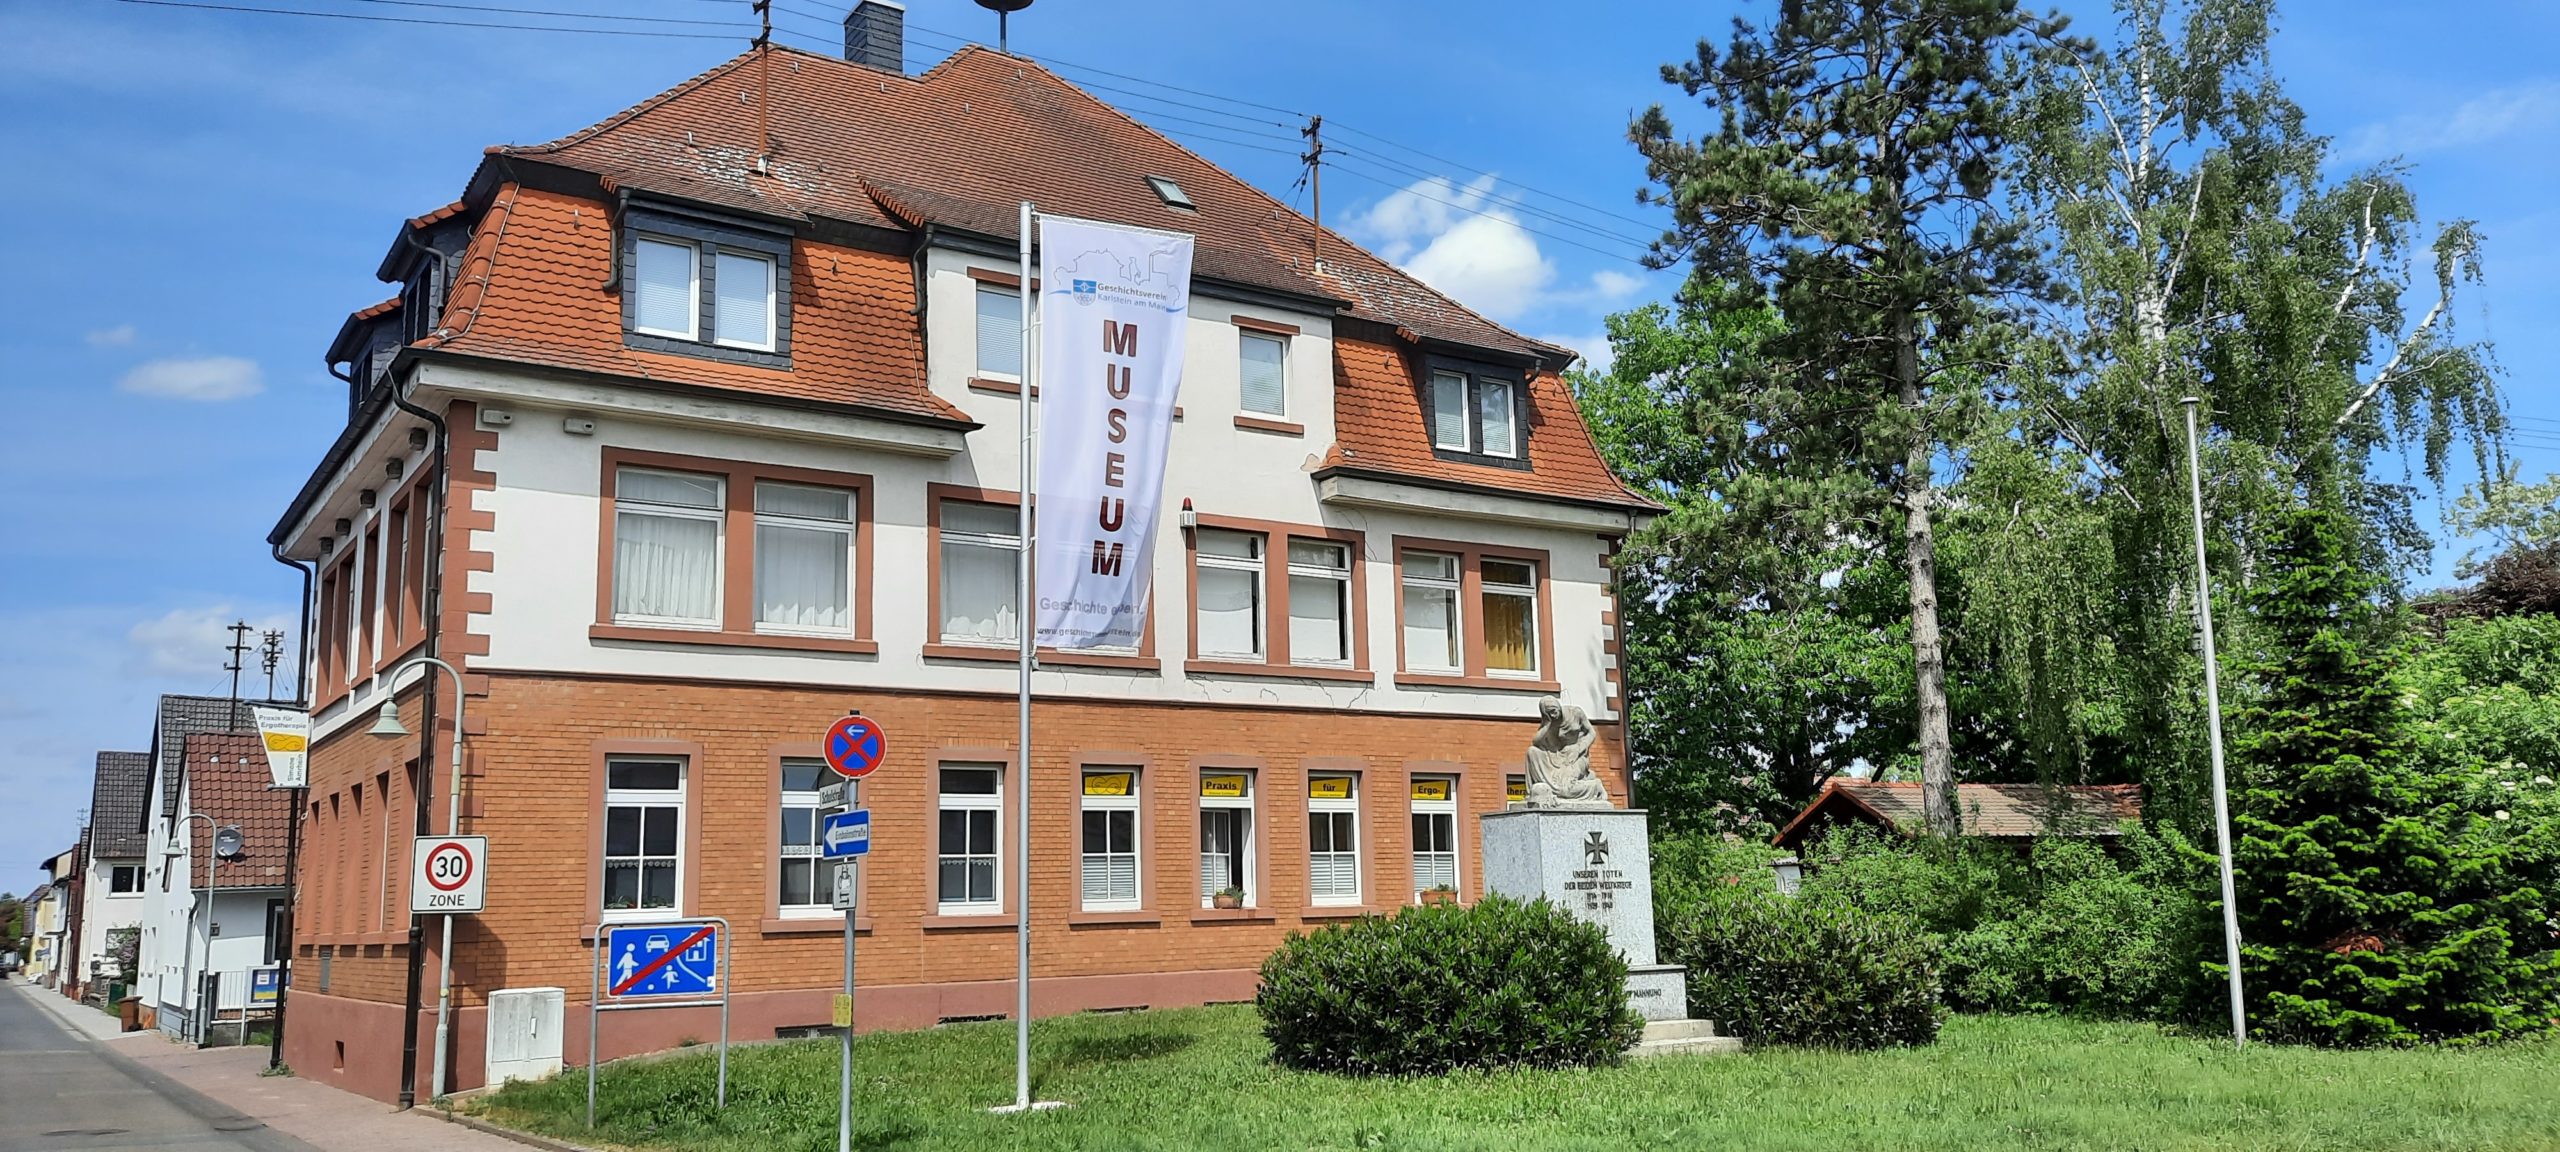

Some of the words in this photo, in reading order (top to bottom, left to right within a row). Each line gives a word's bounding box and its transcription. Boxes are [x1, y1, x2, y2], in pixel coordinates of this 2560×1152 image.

[1097, 282, 1167, 301] Geschichtsverein
[1097, 293, 1132, 305] Karlstein
[1149, 300, 1166, 310] Main
[1091, 319, 1137, 577] MUSEUM
[1039, 597, 1108, 615] Geschichte
[1206, 781, 1237, 790] Praxis
[1322, 783, 1336, 792] für
[1417, 785, 1440, 796] Ergo-
[435, 855, 463, 878] 30
[1572, 870, 1599, 879] UNSEREN
[1602, 870, 1623, 879] TOTEN
[1564, 881, 1576, 890] DER
[429, 894, 465, 907] ZONE
